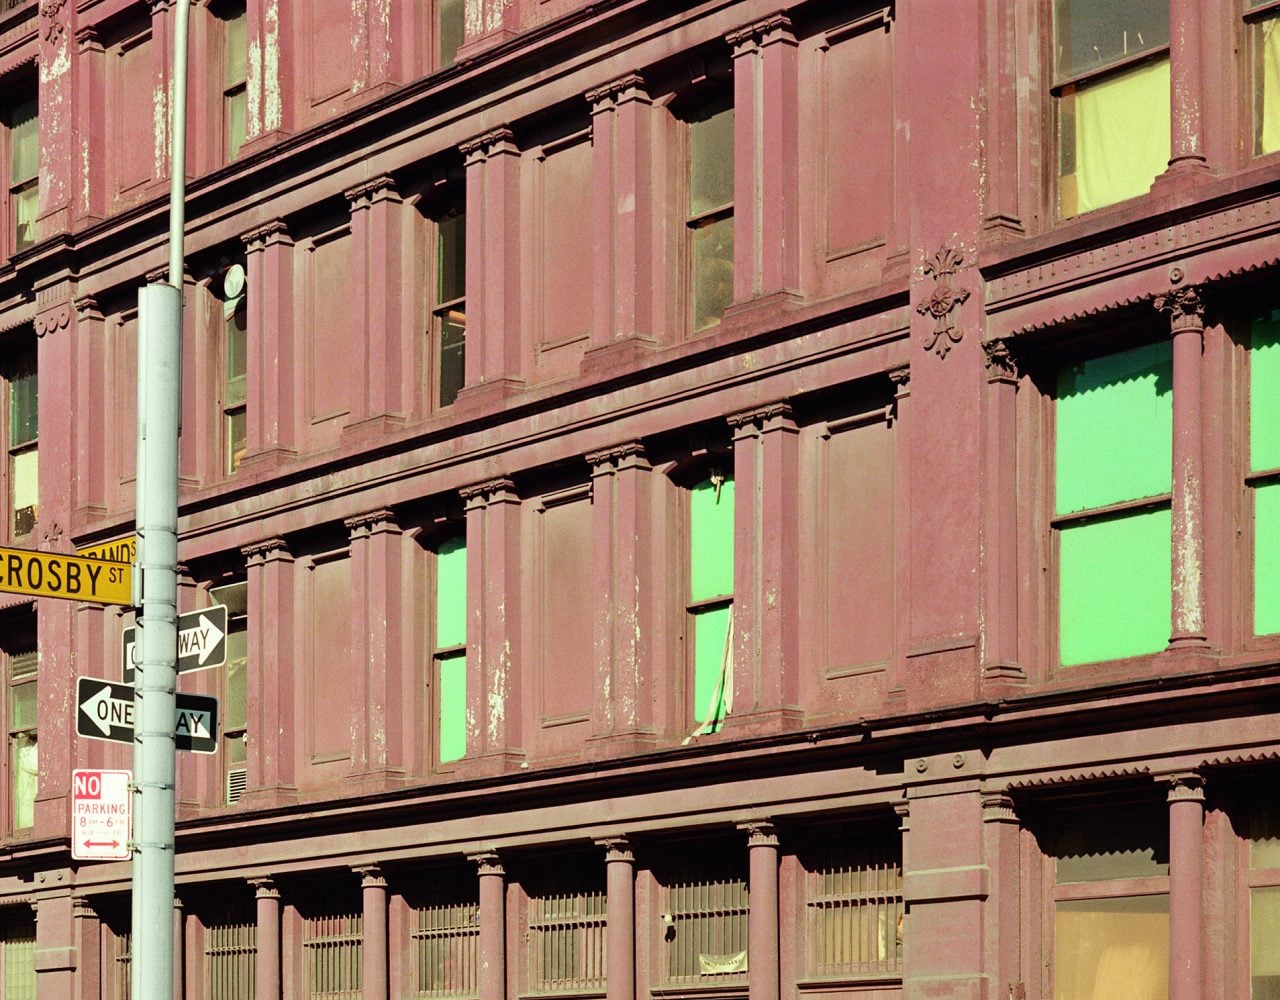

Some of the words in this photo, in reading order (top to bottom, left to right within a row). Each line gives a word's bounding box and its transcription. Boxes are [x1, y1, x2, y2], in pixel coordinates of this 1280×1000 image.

[108, 566, 125, 584] ST
[179, 627, 210, 654] WAY
[97, 699, 134, 726] ONE
[175, 711, 204, 734] AY
[75, 775, 100, 796] NO
[78, 803, 126, 815] PARKING
